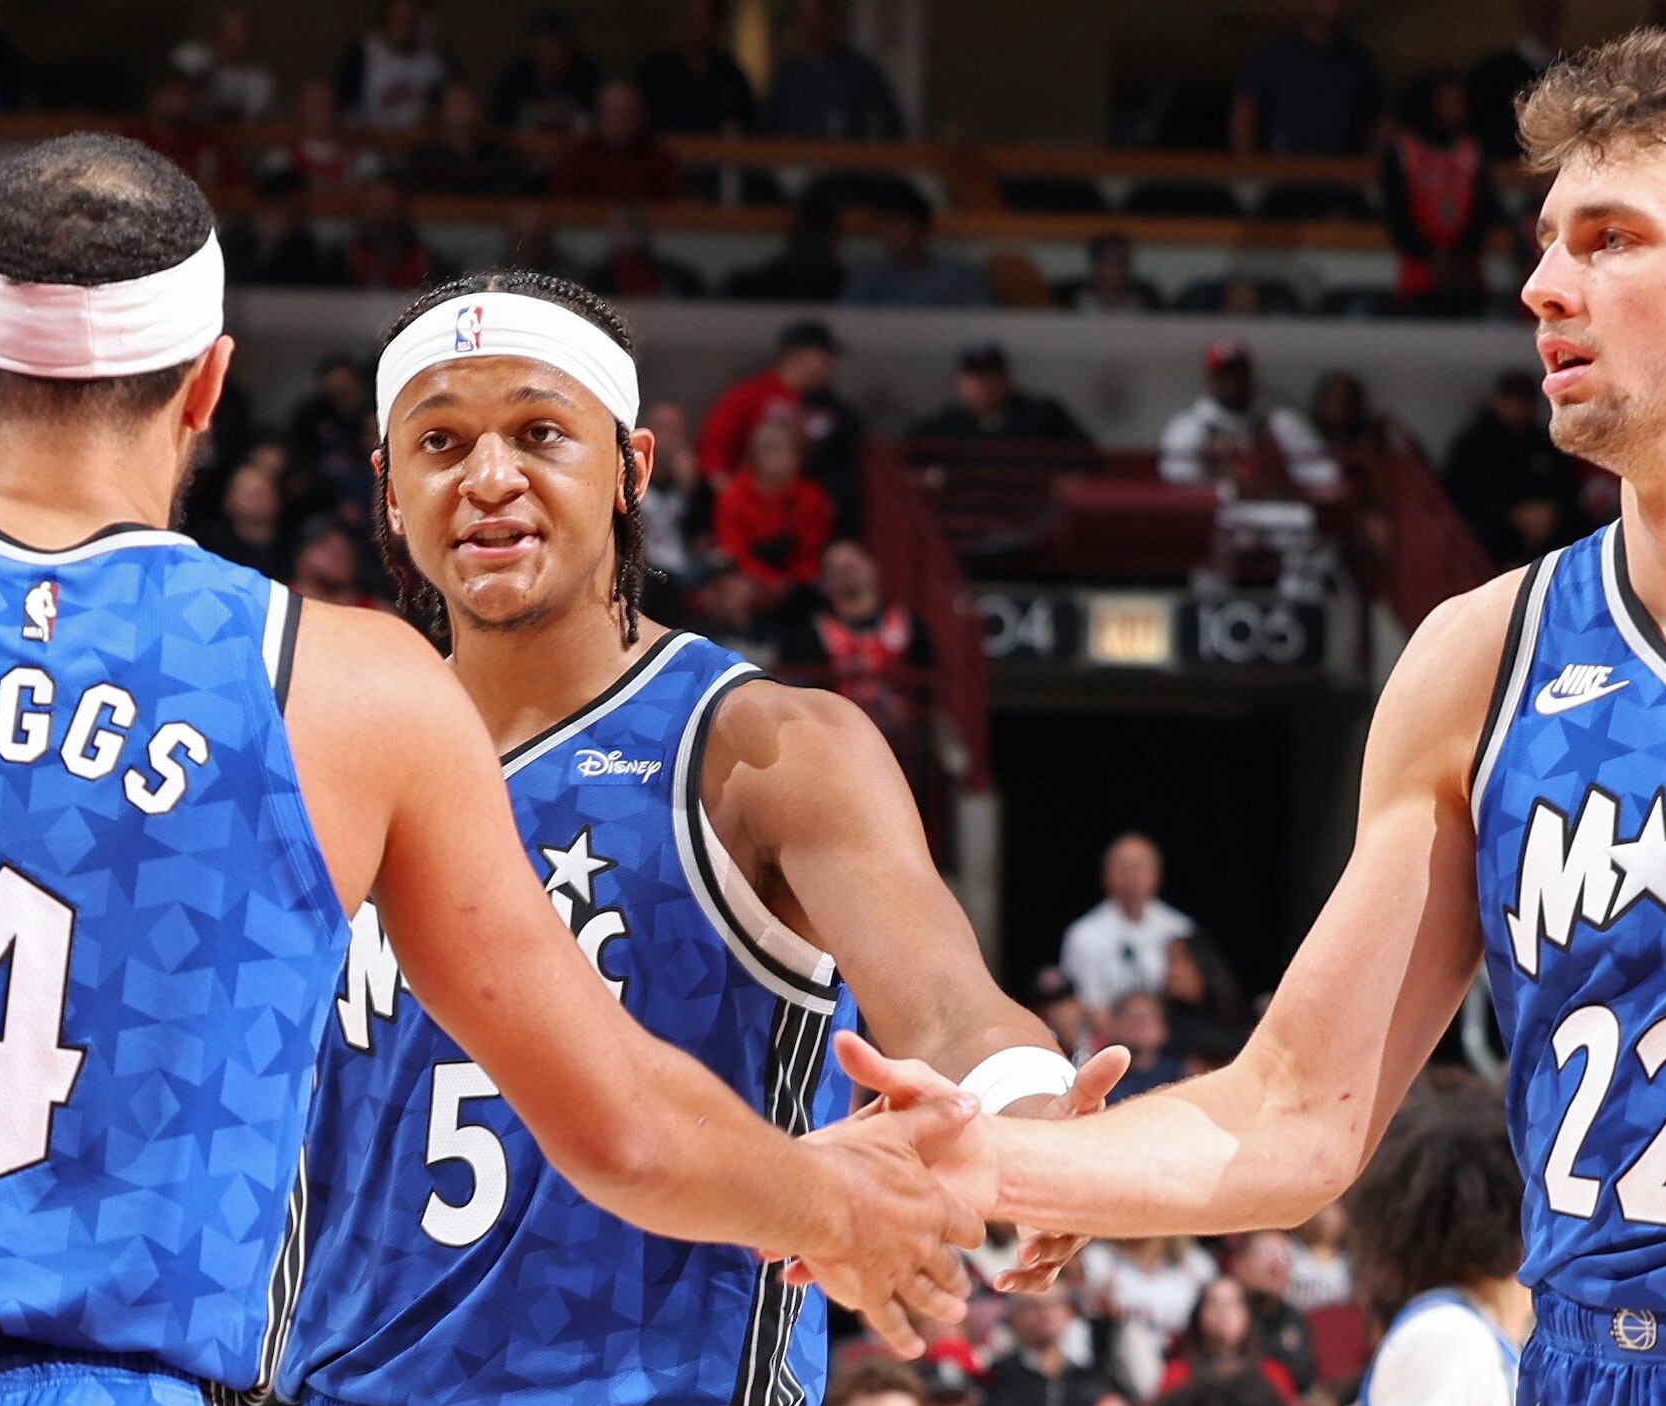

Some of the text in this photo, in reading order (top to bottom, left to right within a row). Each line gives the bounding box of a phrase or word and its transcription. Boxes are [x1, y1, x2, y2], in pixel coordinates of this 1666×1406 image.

[1552, 664, 1614, 695] NIKE
[575, 749, 662, 783] Disney
[418, 1060, 510, 1248] 5
